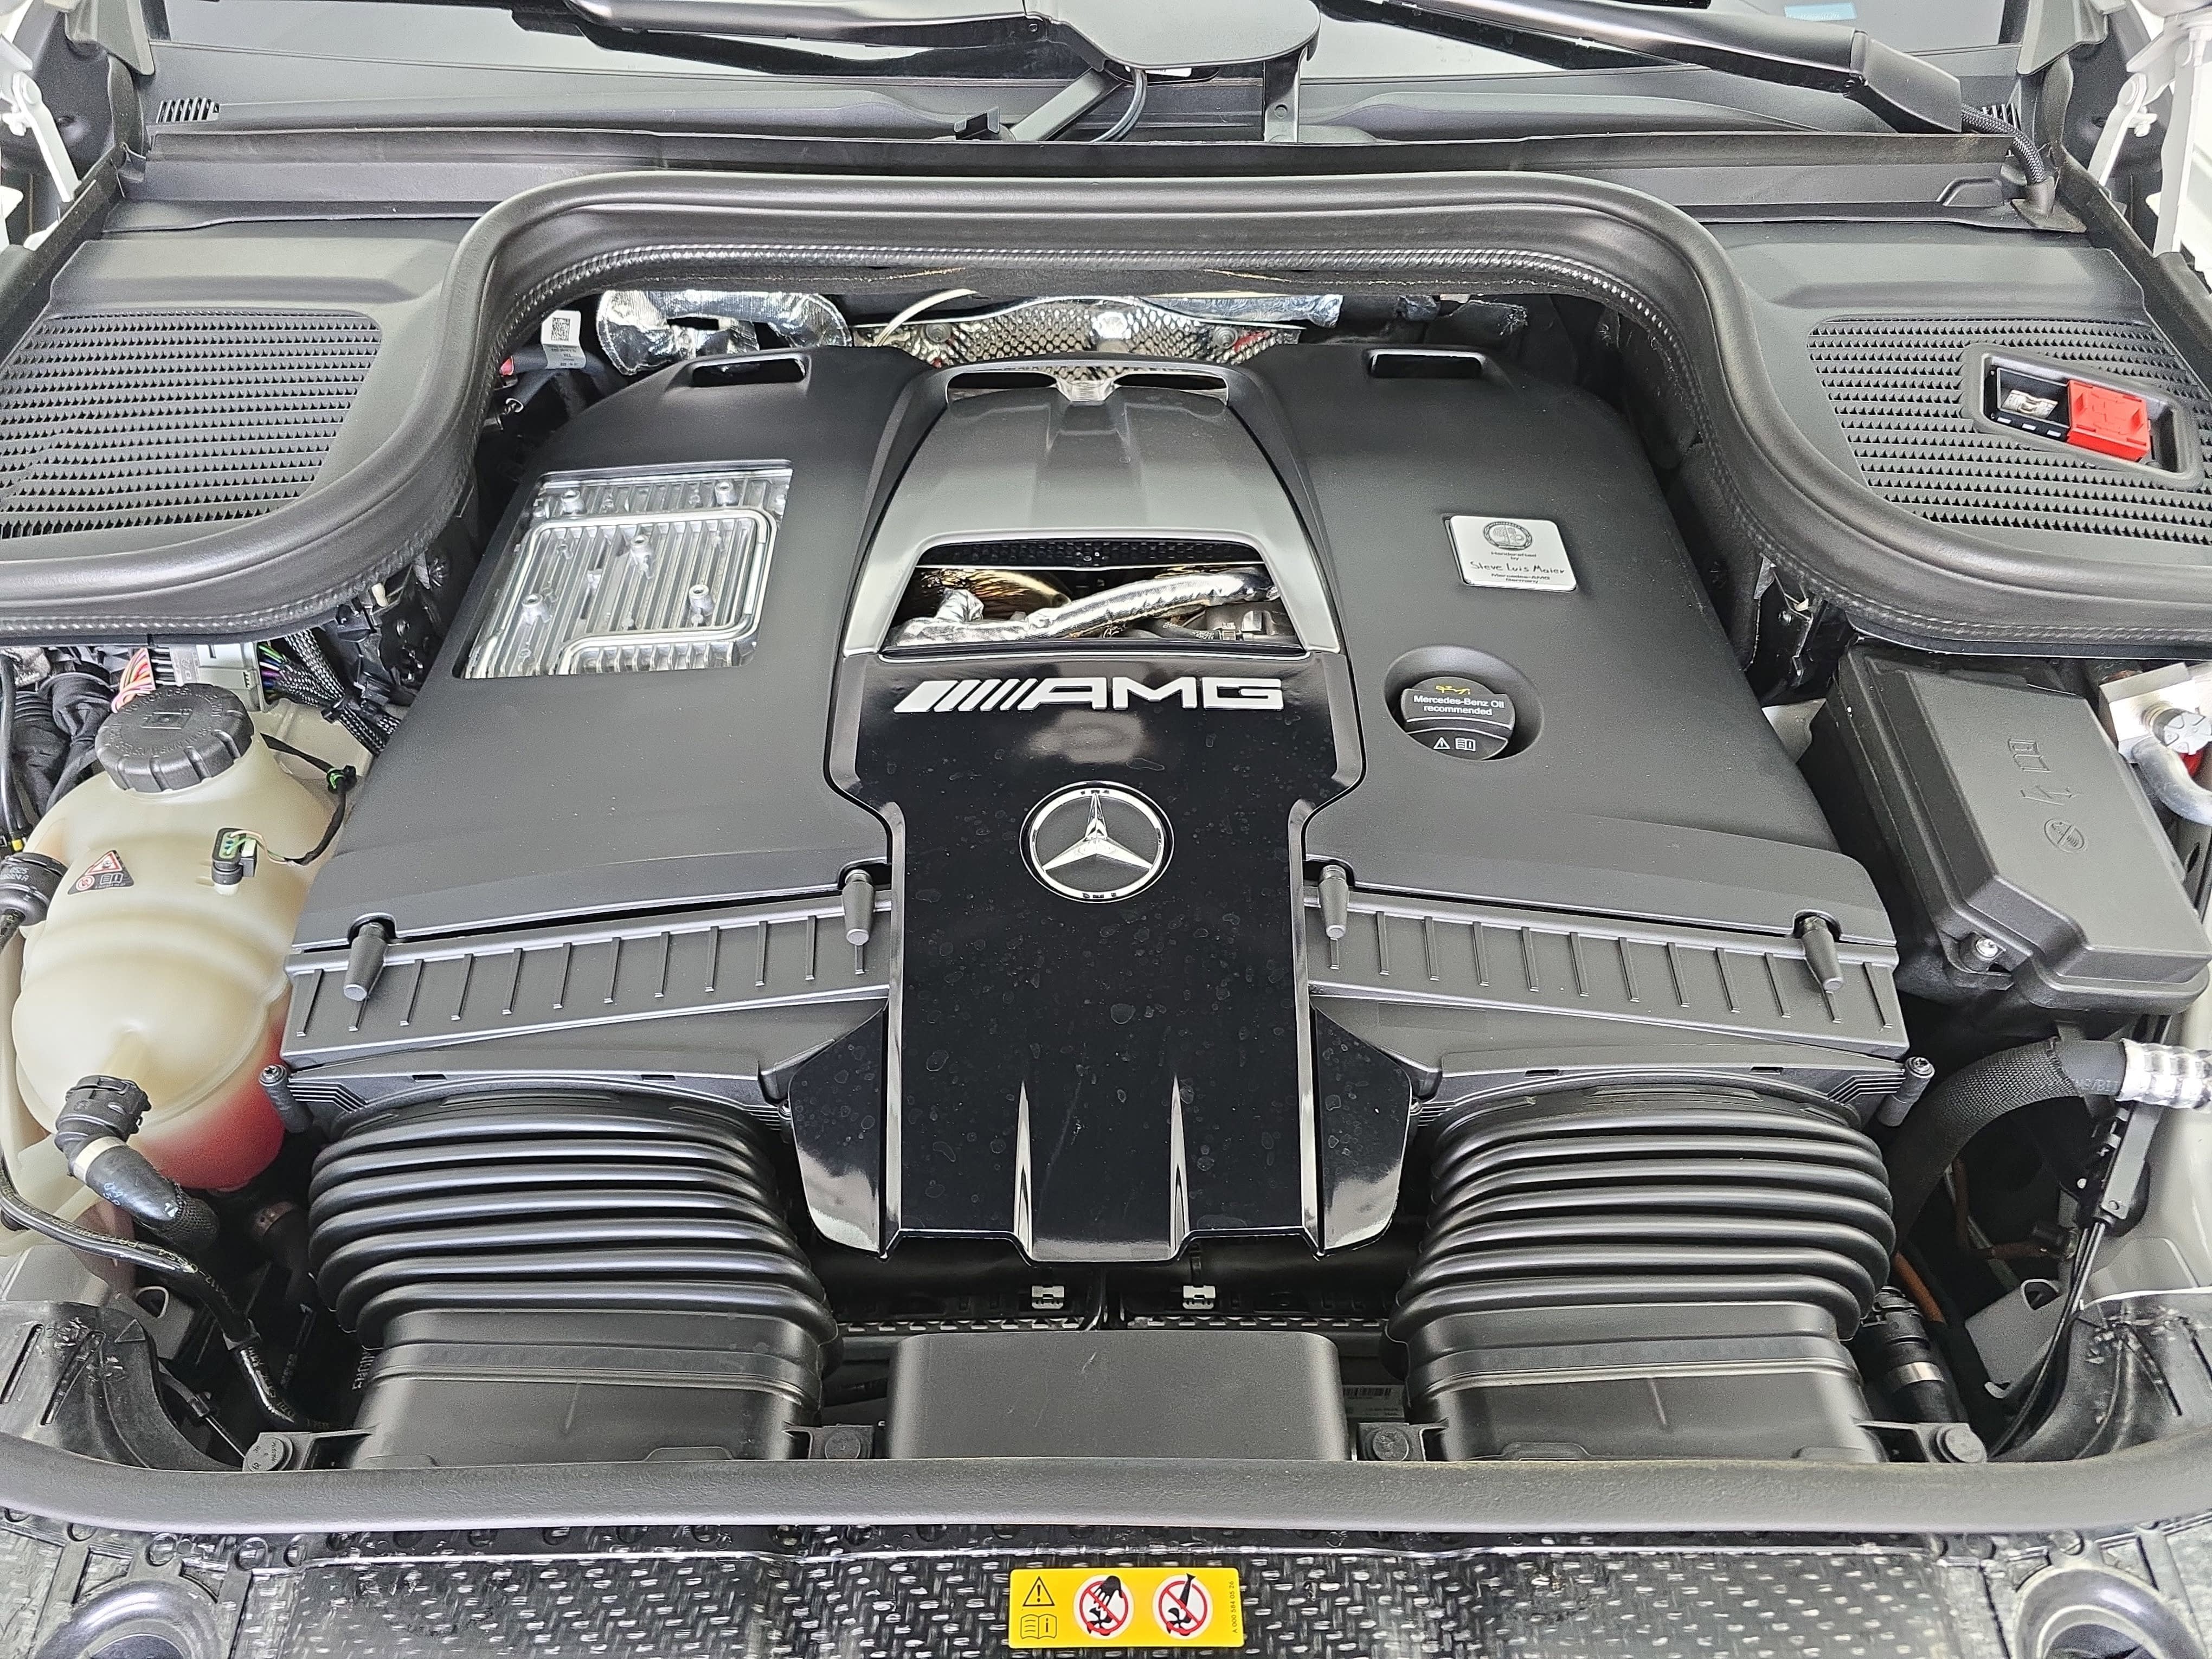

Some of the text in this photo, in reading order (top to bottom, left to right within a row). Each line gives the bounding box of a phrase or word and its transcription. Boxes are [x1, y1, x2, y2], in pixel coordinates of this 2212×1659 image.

[1506, 562, 1529, 572] Luis
[1017, 676, 1284, 710] AMG
[1413, 695, 1505, 709] Mercedes-Benz Oil
[1423, 705, 1493, 716] recommended
[1228, 1580, 1234, 1589] 26
[1229, 1591, 1236, 1599] 05
